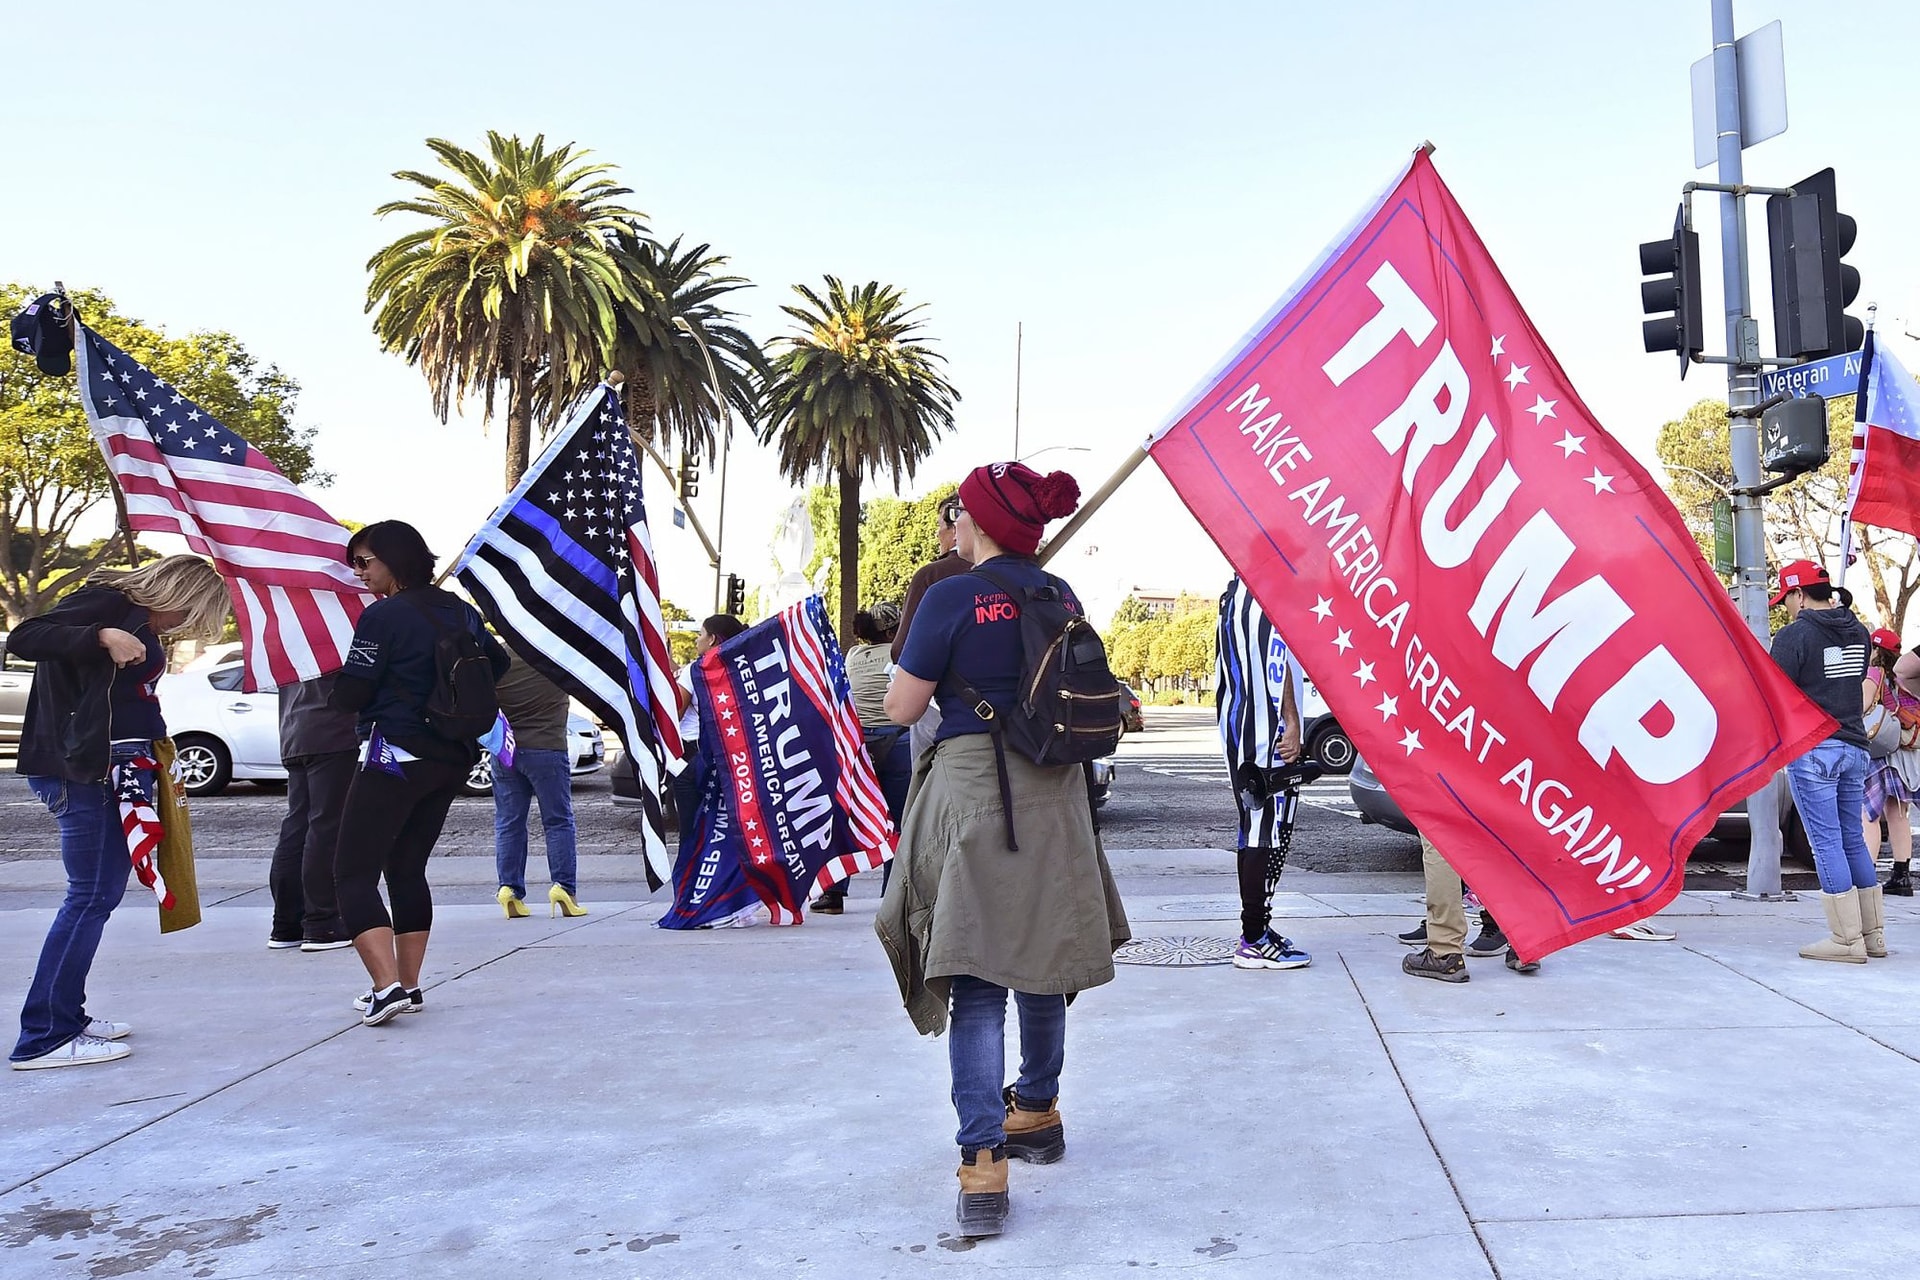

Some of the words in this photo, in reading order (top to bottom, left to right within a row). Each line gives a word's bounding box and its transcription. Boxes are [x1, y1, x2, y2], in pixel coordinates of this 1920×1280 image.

[1768, 365, 1829, 394] Veteran
[1225, 382, 1313, 487] MAKE
[1287, 476, 1411, 648] AMERICA
[1405, 633, 1507, 764] GREAT
[1321, 259, 1718, 785] TRUMP
[731, 751, 753, 804] 2020
[733, 654, 760, 705] KEEP
[751, 713, 783, 806] AMERICA
[775, 811, 807, 880] GREAT!
[753, 637, 834, 850] TRUMP
